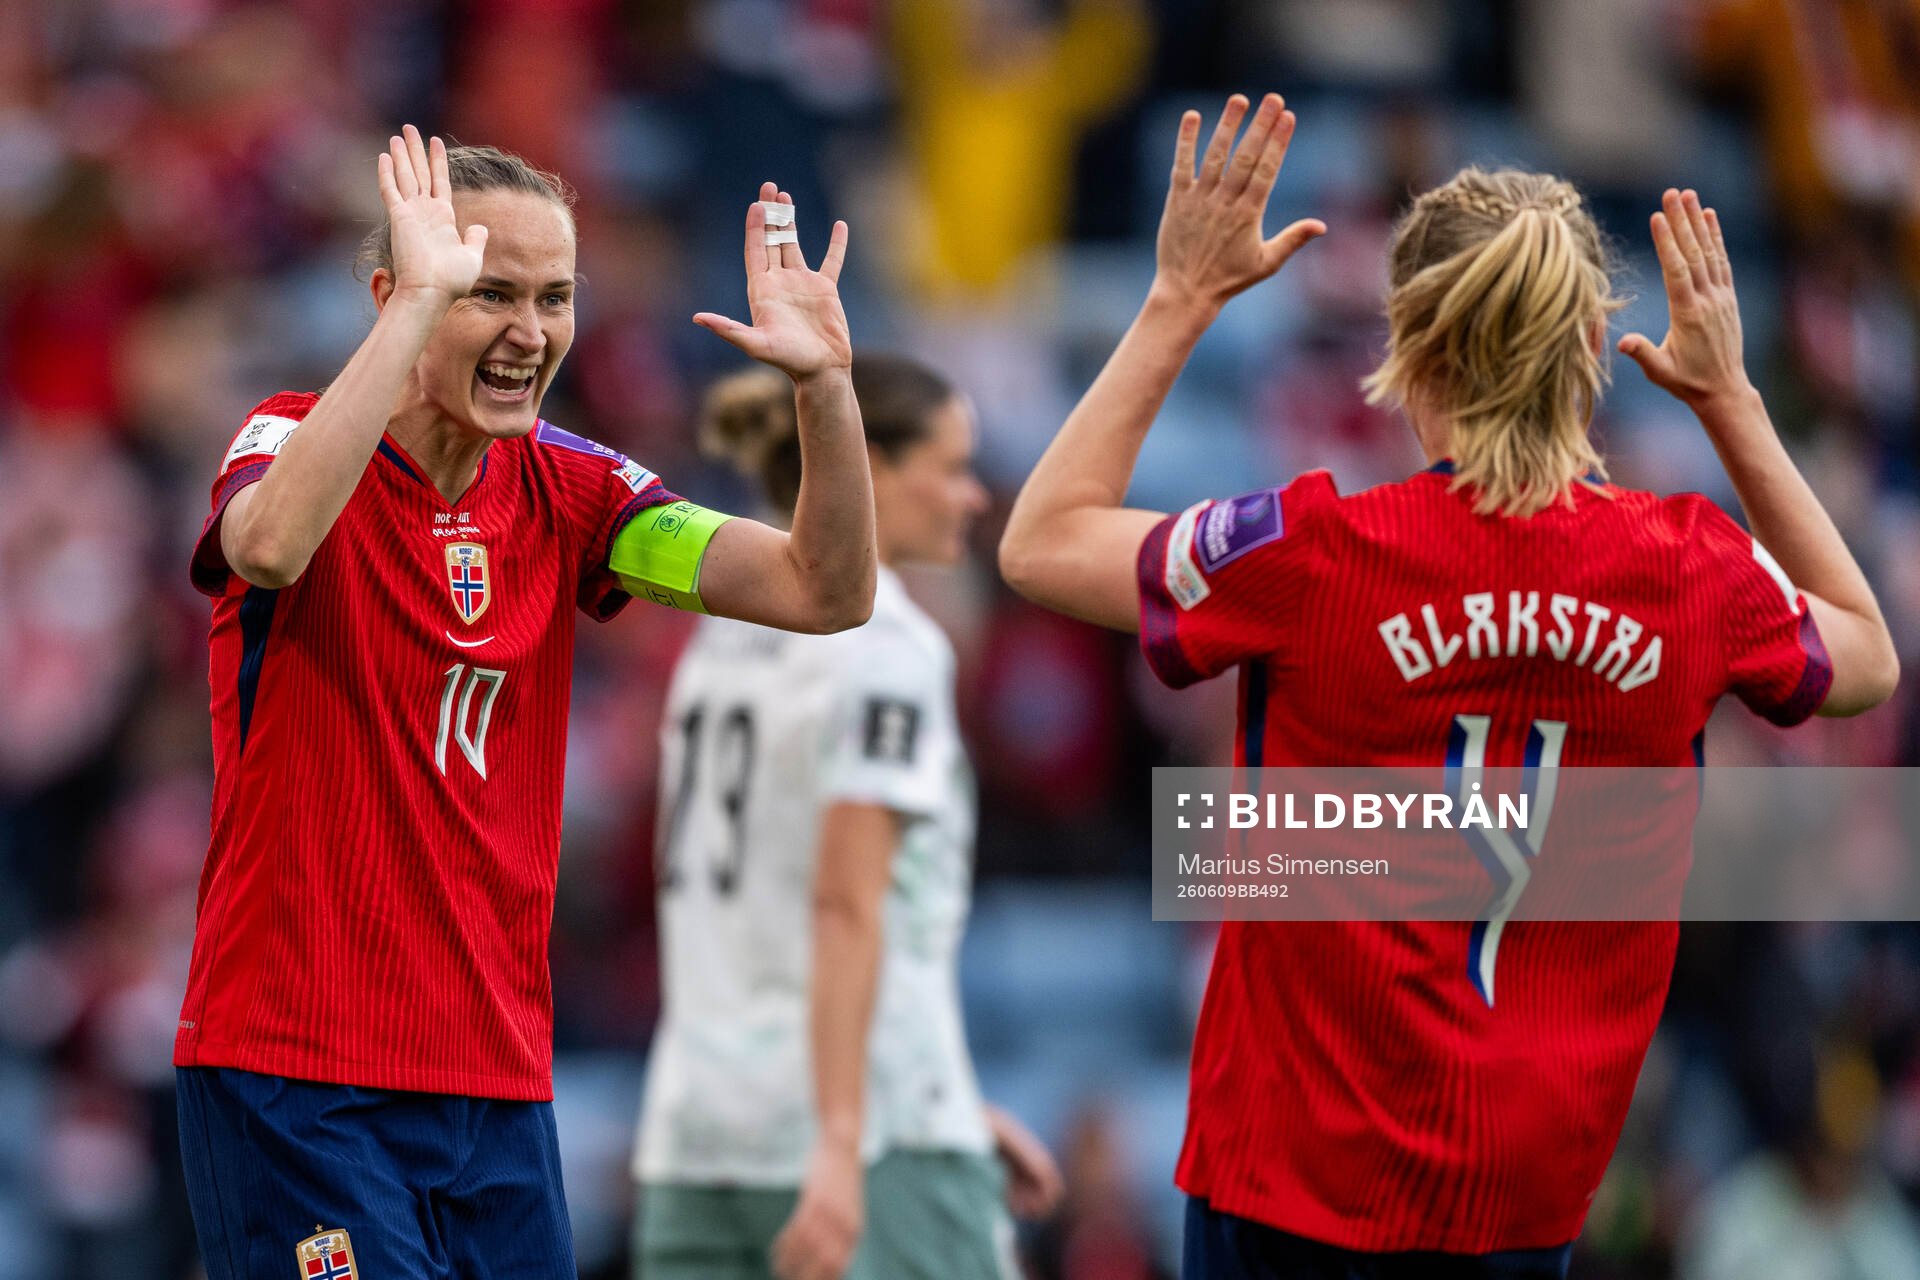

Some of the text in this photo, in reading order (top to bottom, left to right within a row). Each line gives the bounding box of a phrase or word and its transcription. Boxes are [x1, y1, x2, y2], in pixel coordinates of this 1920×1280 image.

[435, 512, 451, 524] NOR
[1378, 591, 1662, 692] BLAKSTAD
[435, 663, 507, 781] 10
[1443, 714, 1568, 1008] 4
